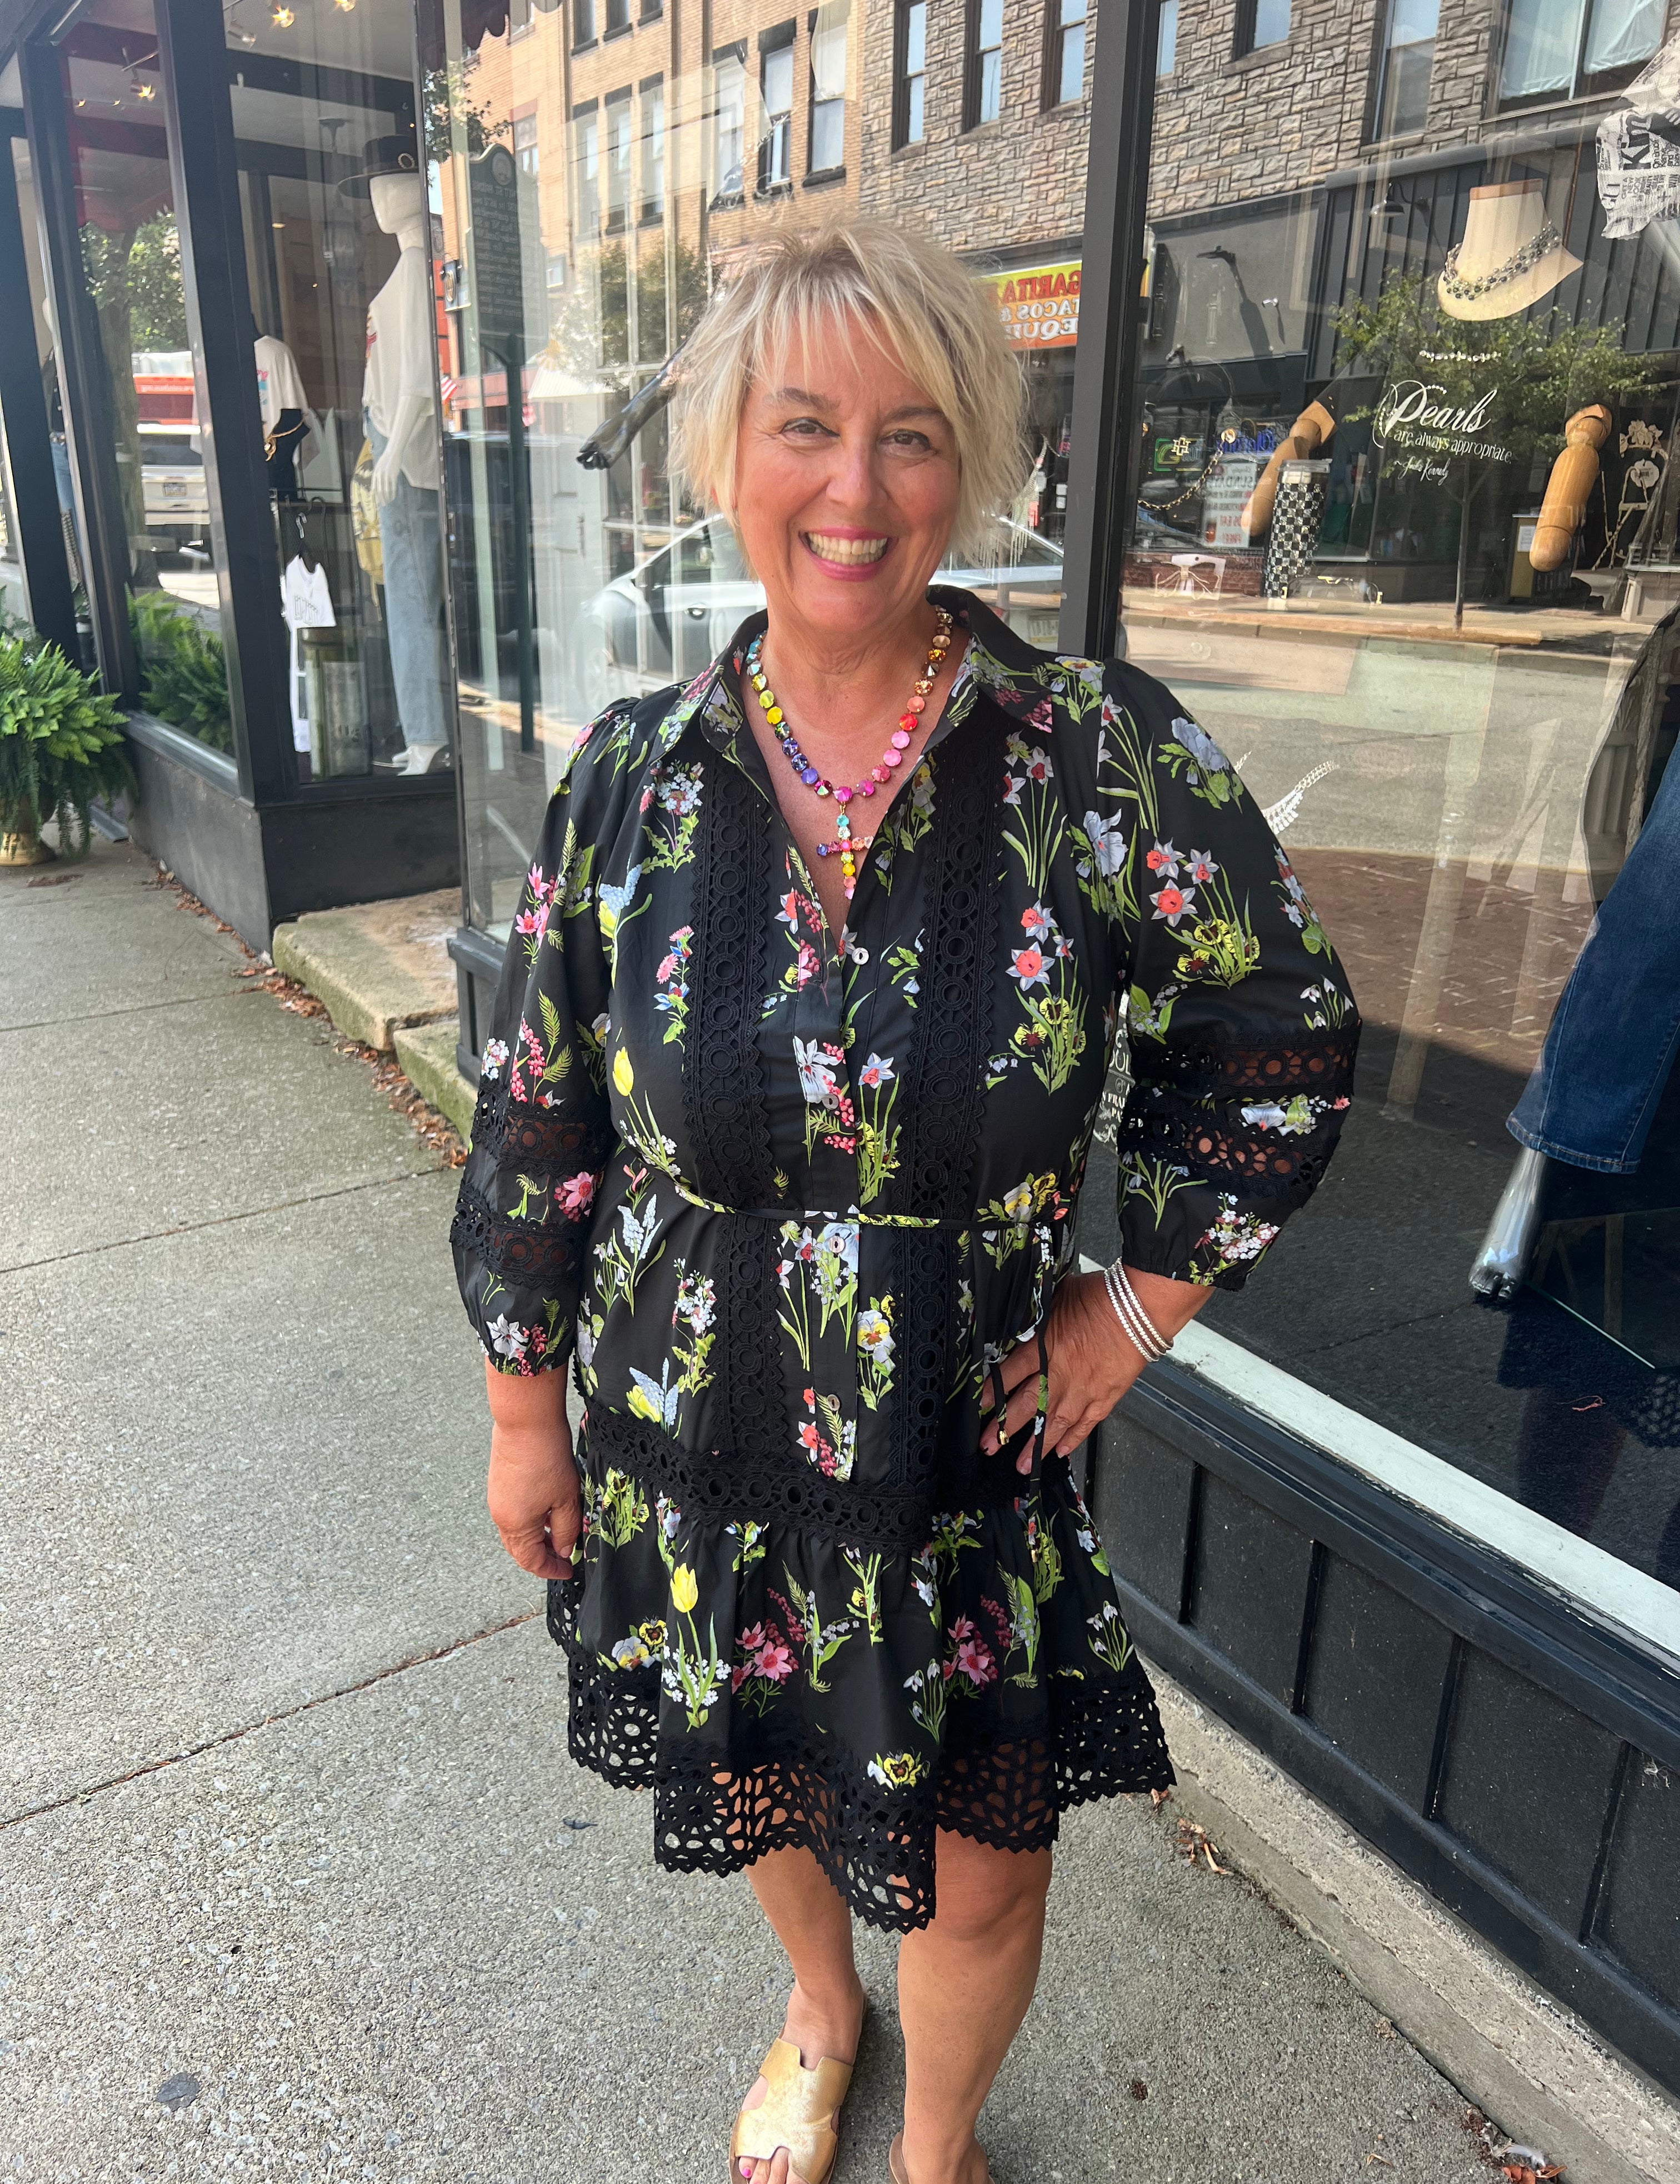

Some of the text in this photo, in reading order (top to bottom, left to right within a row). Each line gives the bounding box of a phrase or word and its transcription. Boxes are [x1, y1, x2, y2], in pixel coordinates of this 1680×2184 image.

[1372, 379, 1497, 449] Pearls
[1393, 430, 1512, 464] are always appropriate.
